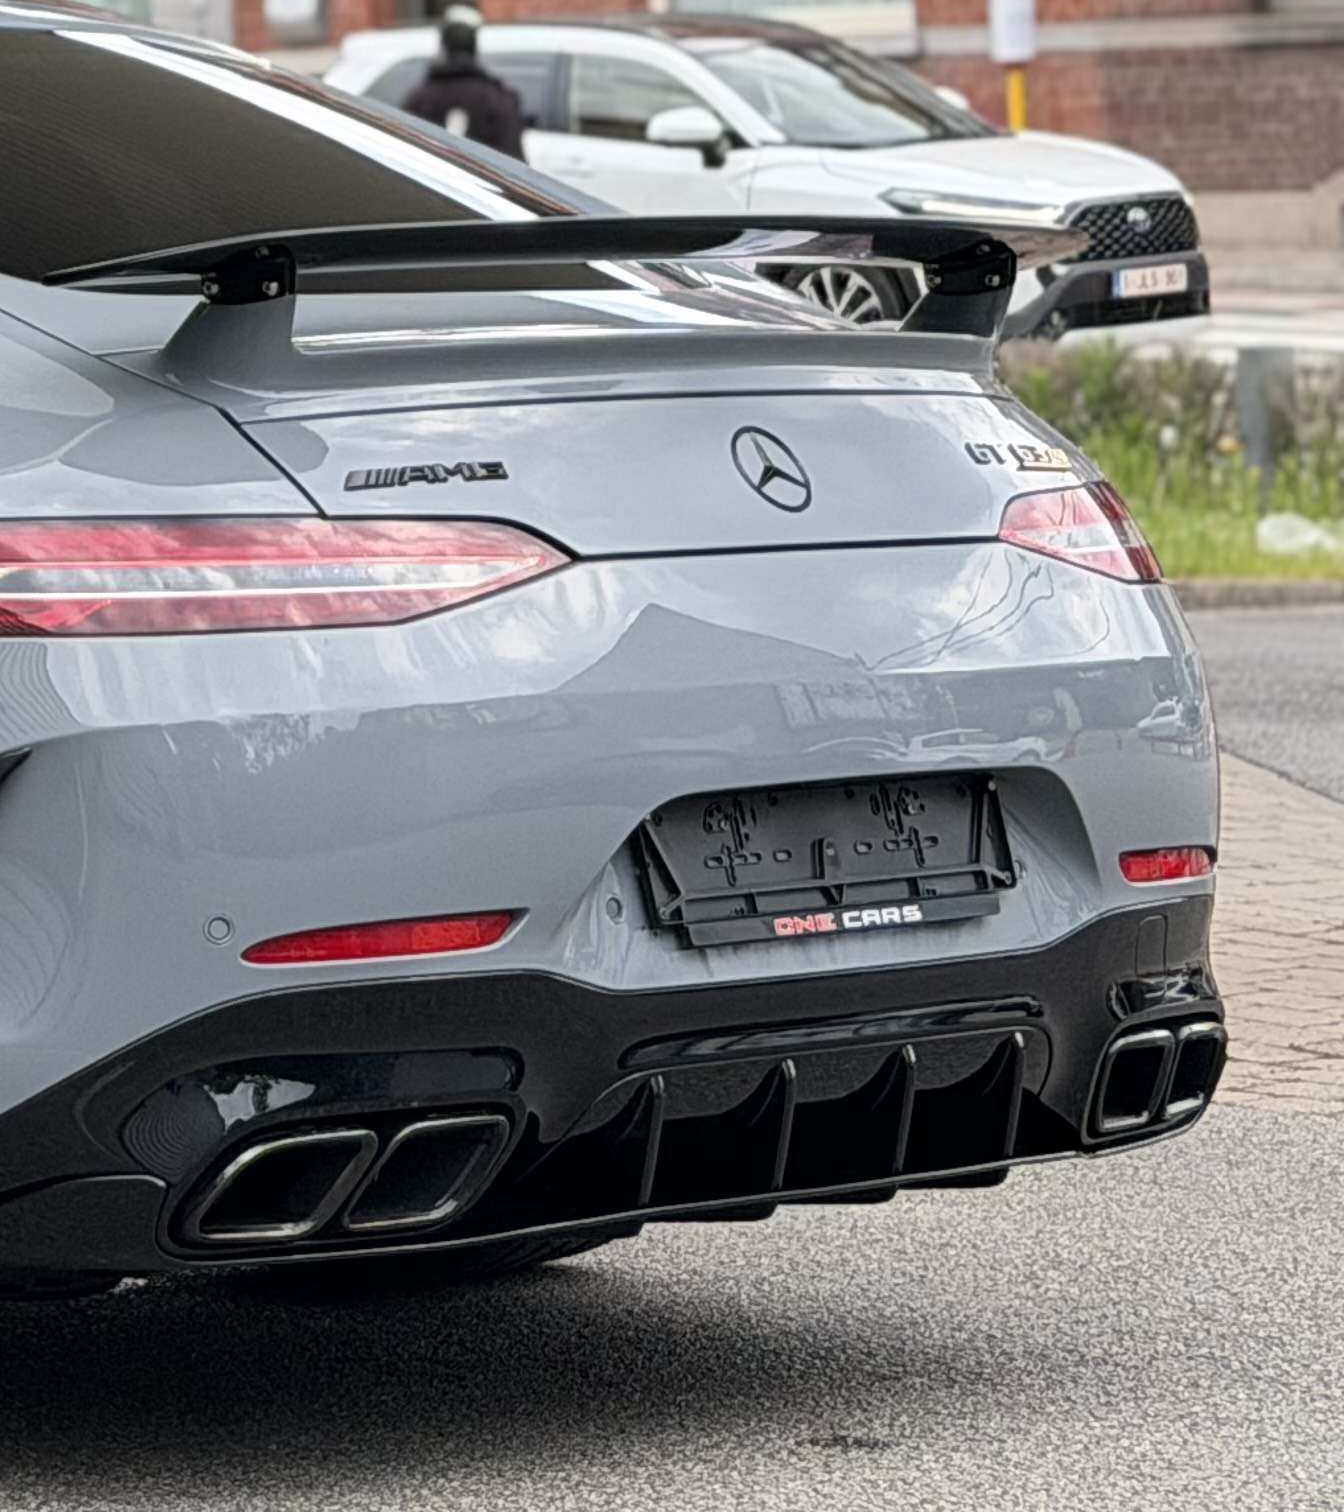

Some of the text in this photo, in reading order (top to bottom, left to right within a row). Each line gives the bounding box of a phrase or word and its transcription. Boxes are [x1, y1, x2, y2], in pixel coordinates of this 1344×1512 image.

[397, 461, 509, 487] AMG
[773, 904, 923, 936] ONE CARS
